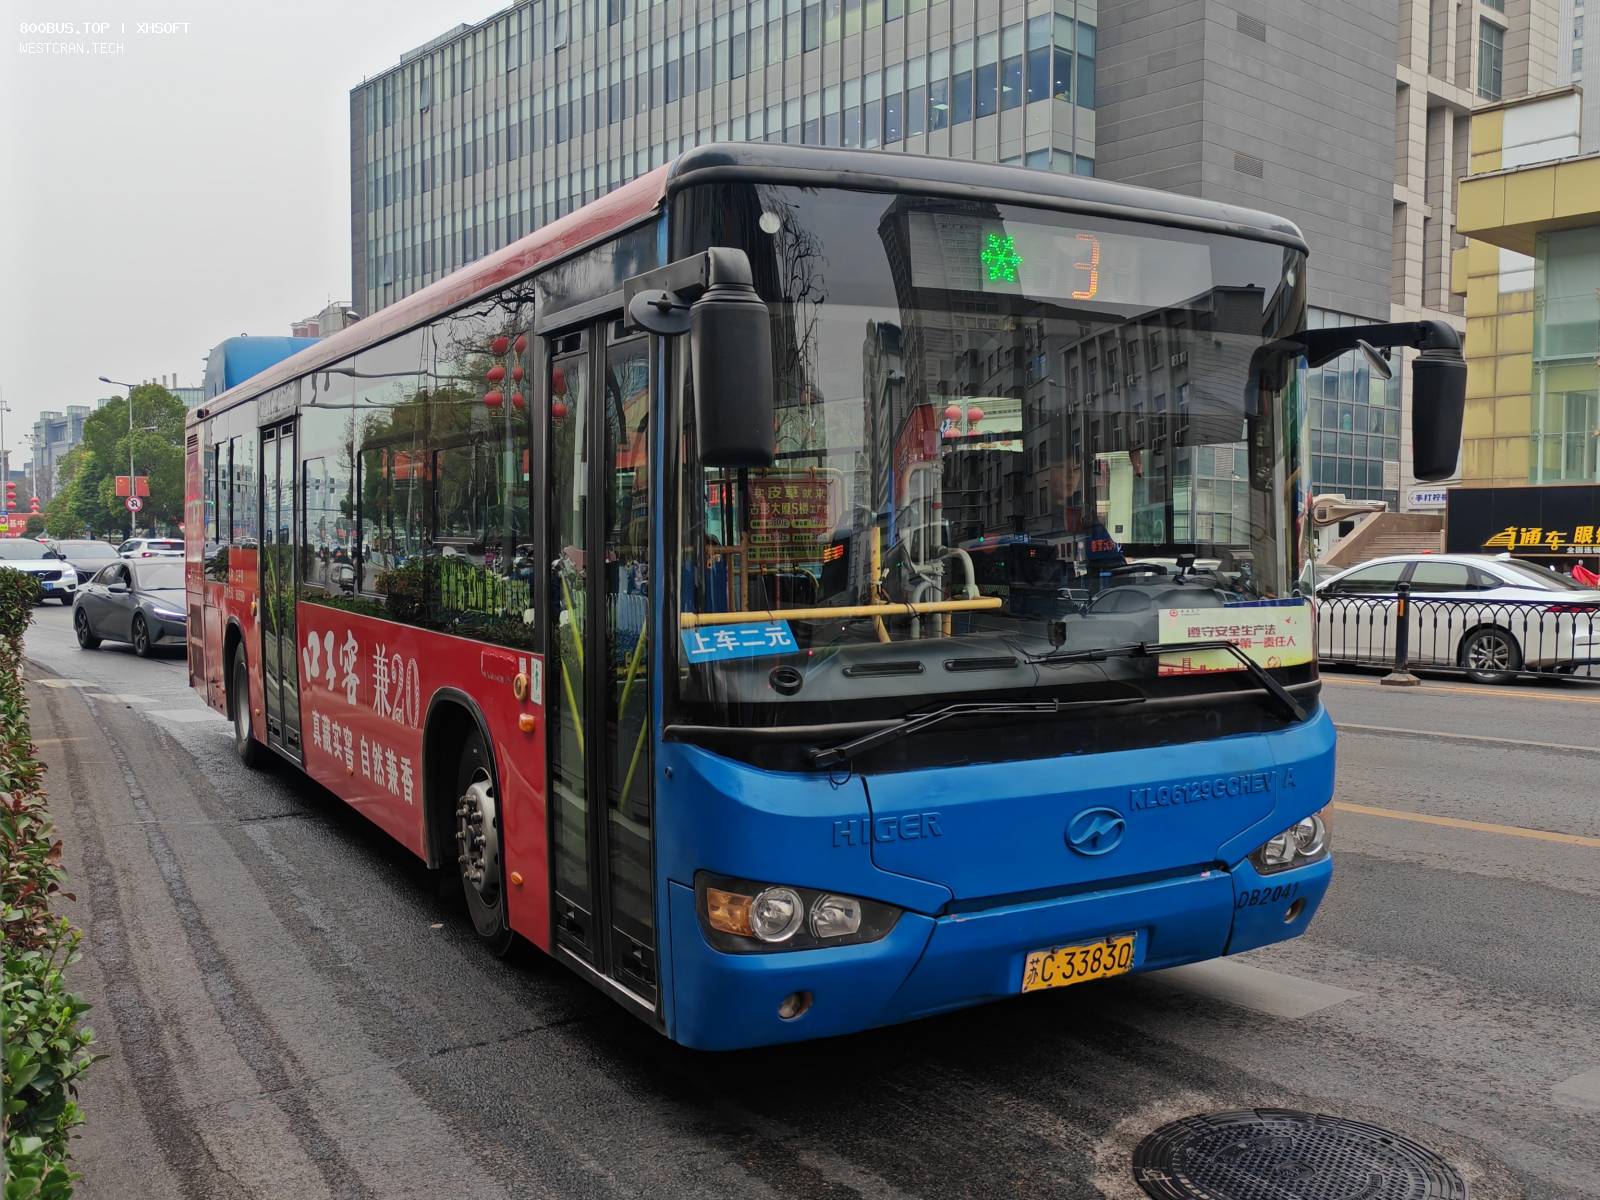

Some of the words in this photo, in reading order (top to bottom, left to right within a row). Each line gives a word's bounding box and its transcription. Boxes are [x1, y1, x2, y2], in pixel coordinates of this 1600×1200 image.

[1072, 234, 1100, 298] 3
[1573, 525, 1600, 545] 眼
[690, 626, 791, 655] 上车二元
[1187, 624, 1277, 638] 遵守安全生产法
[302, 629, 360, 706] 口子窖
[372, 643, 421, 730] 兼20
[360, 735, 413, 806] 自然兼香
[832, 812, 943, 848] HIGER
[1236, 882, 1298, 910] DB2041
